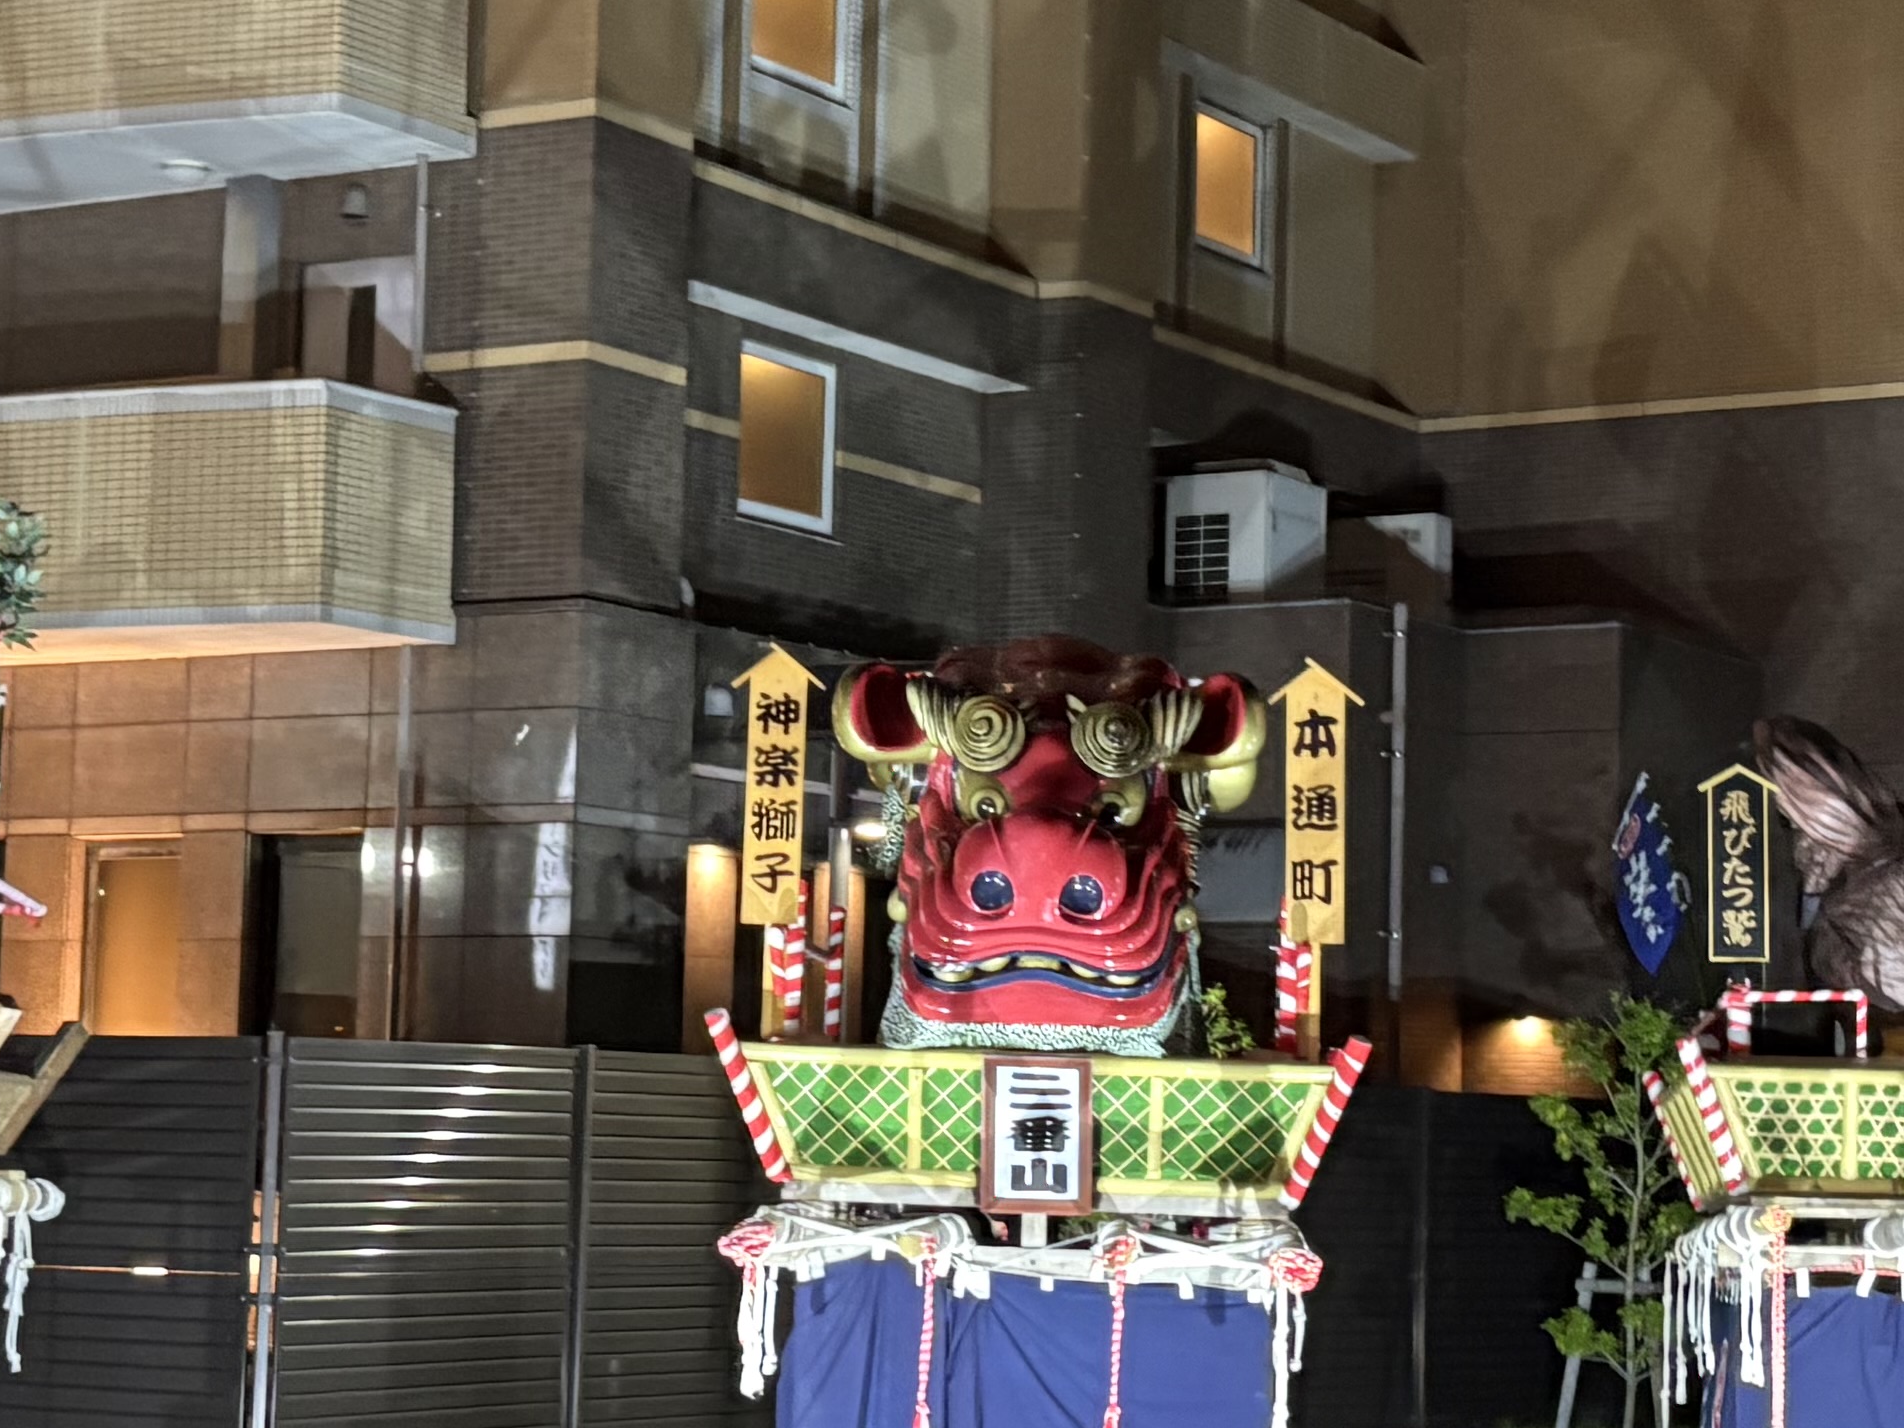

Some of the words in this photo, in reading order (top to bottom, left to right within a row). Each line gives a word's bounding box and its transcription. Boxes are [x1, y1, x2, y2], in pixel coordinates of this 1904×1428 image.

[750, 691, 801, 895] 神楽獅子
[1291, 708, 1340, 906] 本通町
[1006, 1071, 1073, 1194] 三番山
